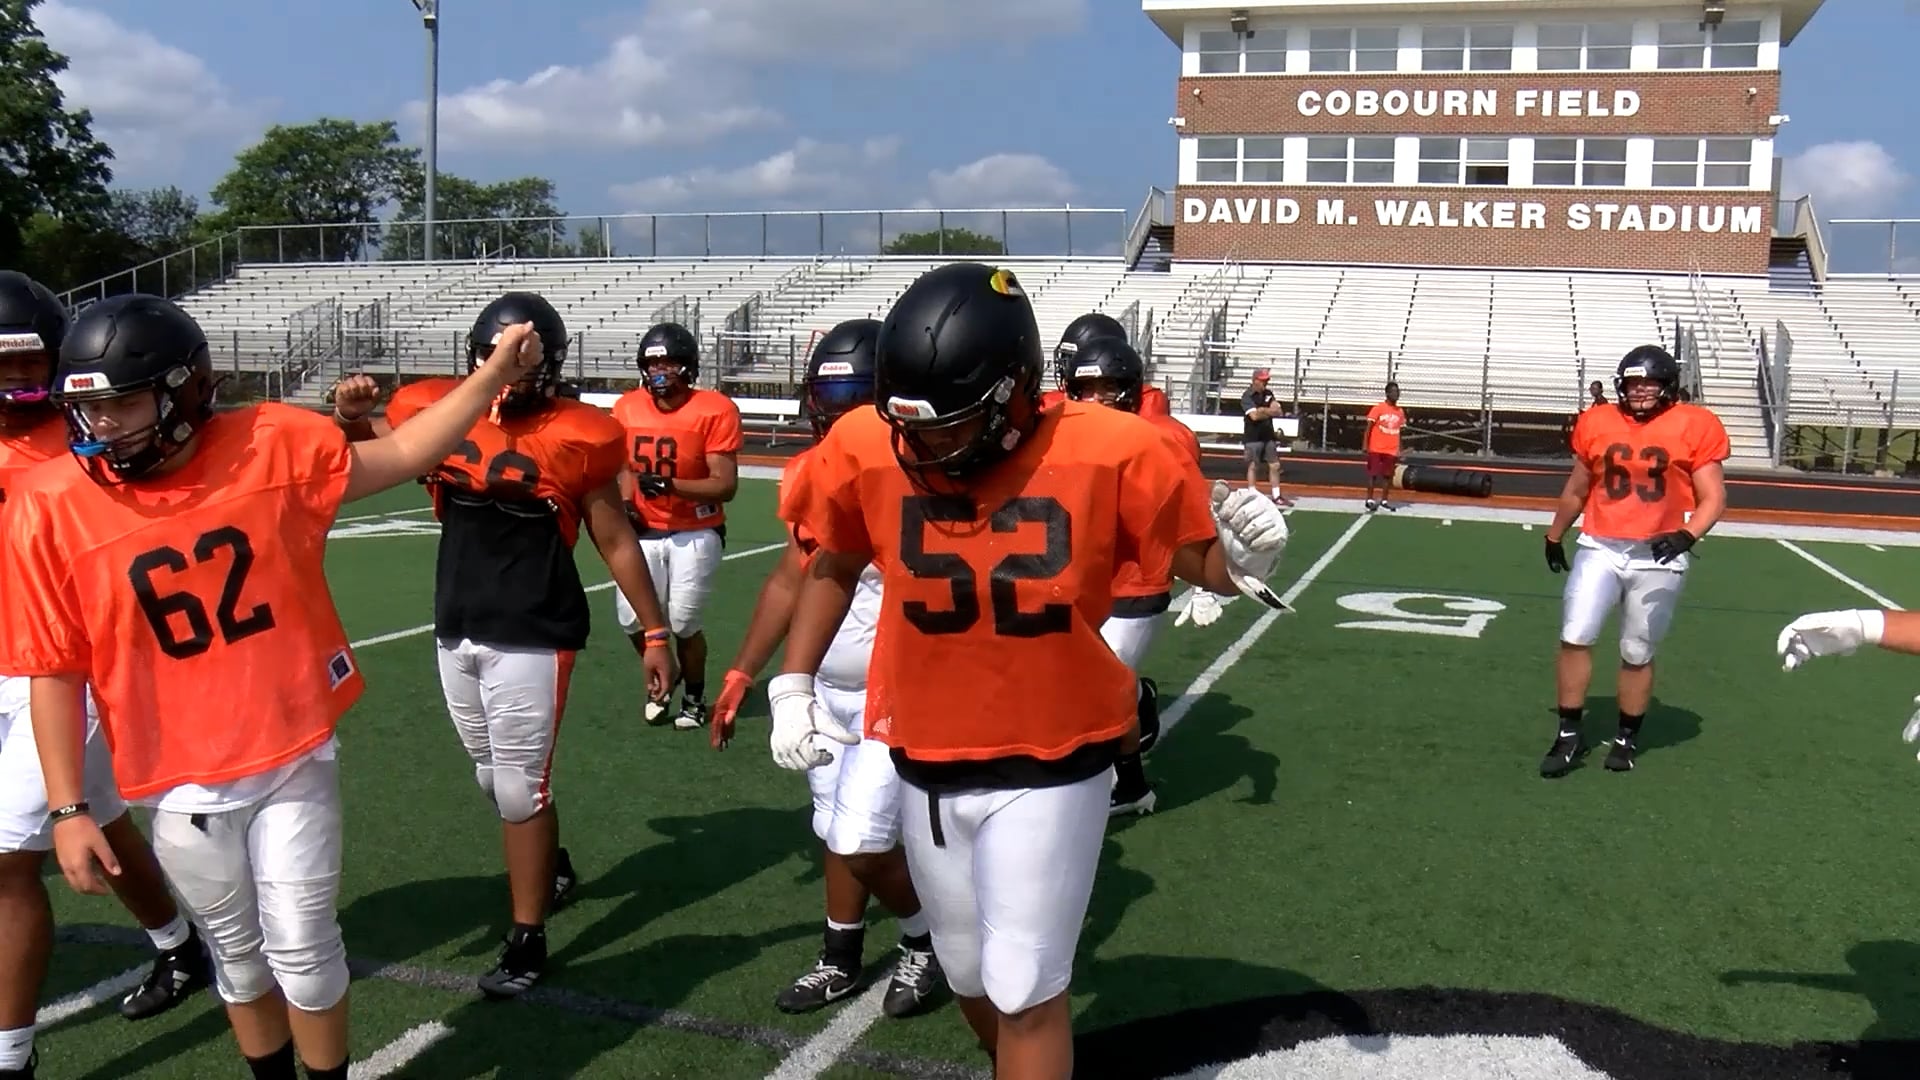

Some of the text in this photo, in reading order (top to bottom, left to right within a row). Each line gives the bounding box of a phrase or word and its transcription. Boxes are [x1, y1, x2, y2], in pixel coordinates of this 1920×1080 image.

[1297, 89, 1641, 117] COBOURN FIELD
[1183, 198, 1762, 234] DAVID M. WALKER STADIUM
[634, 435, 677, 479] 58
[1604, 443, 1669, 503] 63
[128, 525, 275, 660] 62
[901, 496, 1072, 638] 52
